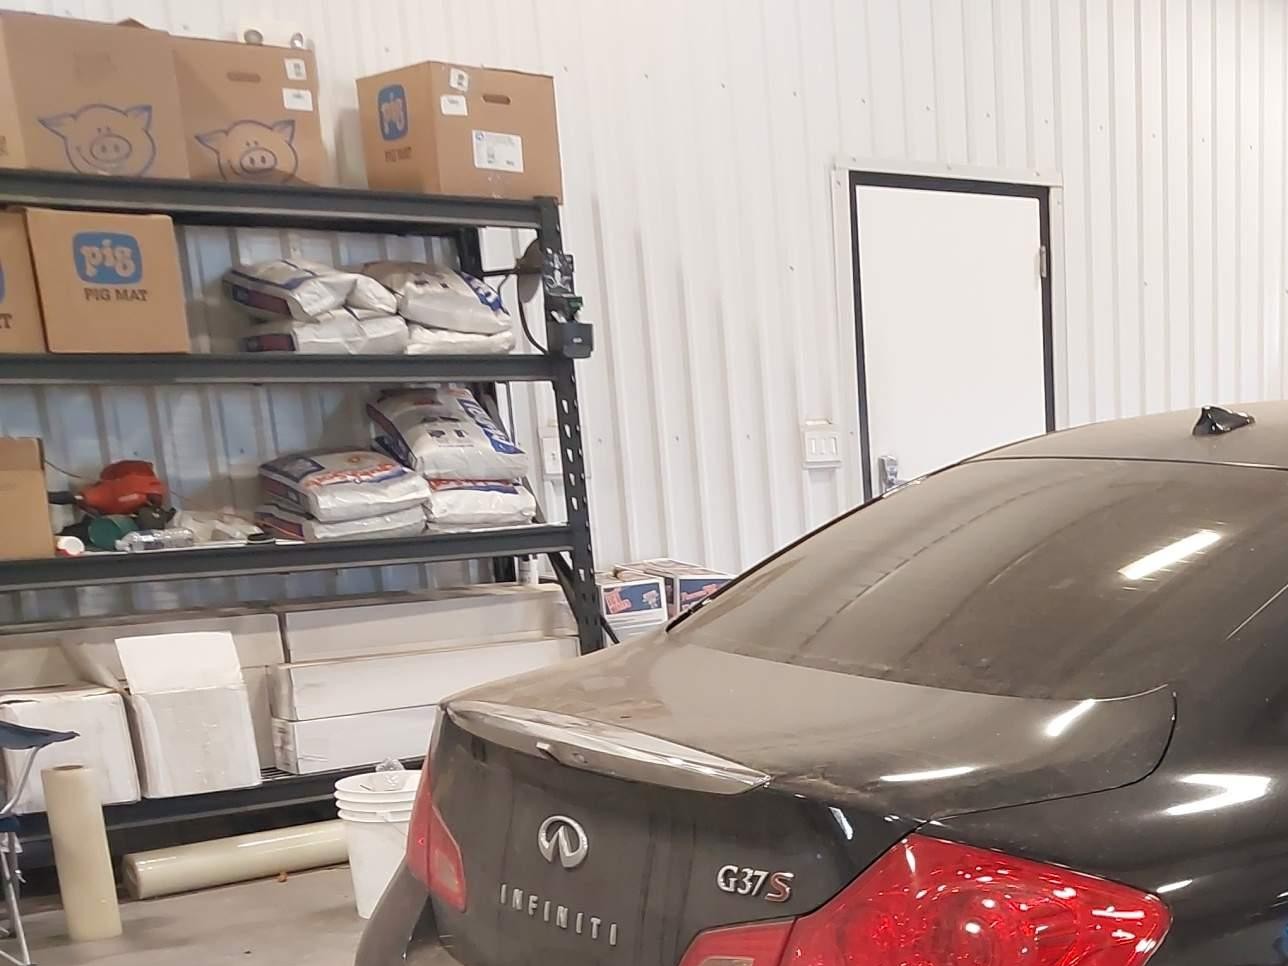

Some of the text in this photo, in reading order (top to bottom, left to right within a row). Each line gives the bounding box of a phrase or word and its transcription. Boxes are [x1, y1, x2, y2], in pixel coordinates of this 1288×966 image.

[80, 239, 135, 277] pig
[84, 288, 149, 301] PIG MAT
[717, 864, 795, 903] G37S
[500, 884, 618, 947] INFINITI
